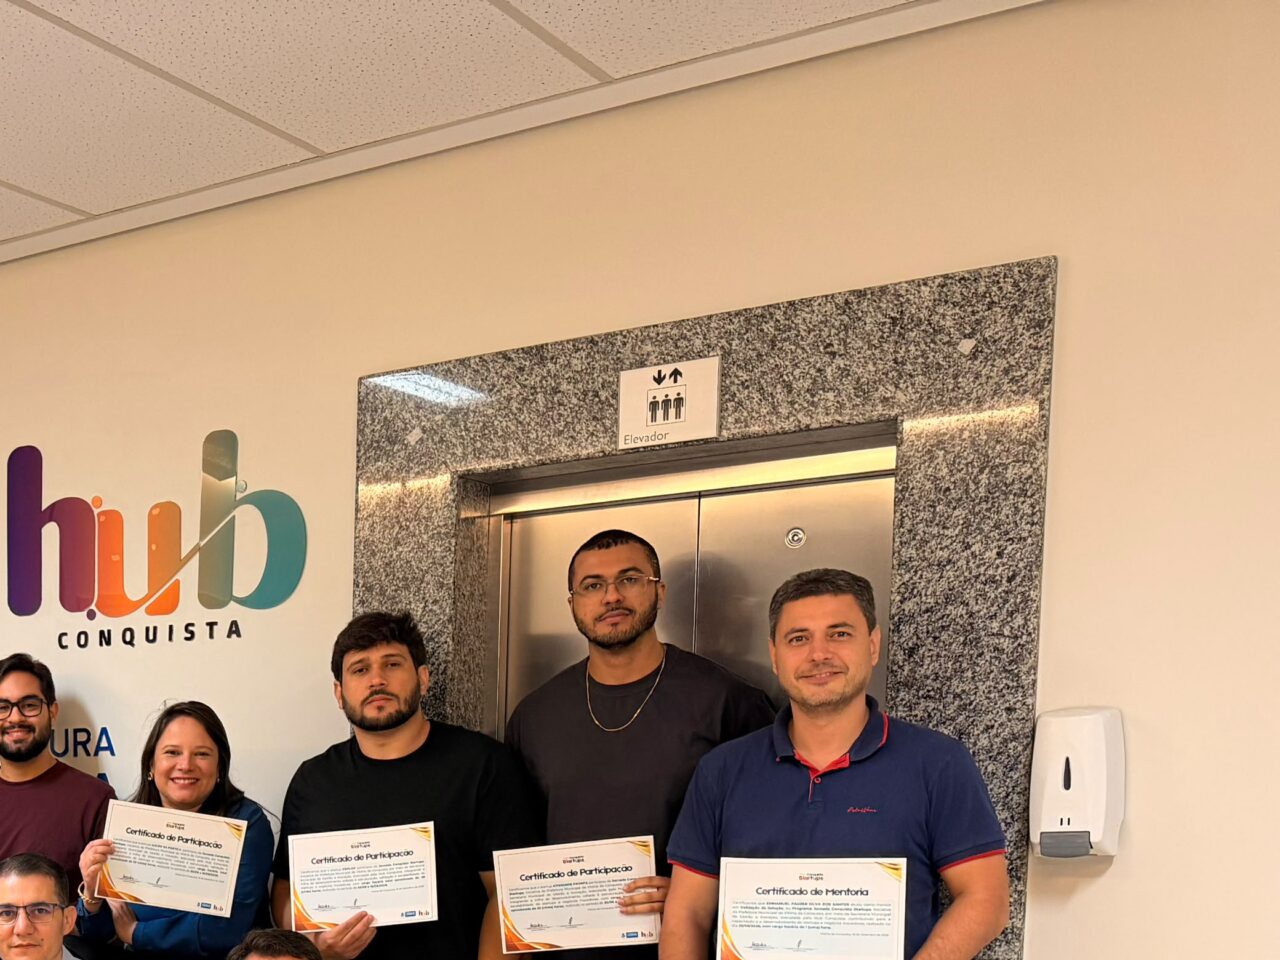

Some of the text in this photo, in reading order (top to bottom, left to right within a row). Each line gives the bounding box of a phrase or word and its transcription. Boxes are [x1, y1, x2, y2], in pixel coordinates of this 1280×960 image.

[623, 430, 670, 445] Elevador
[6, 428, 308, 619] hub
[57, 619, 242, 650] CONQUISTA
[125, 827, 166, 841] Certificado
[166, 833, 176, 842] de
[311, 854, 353, 865] Certificado
[353, 853, 365, 862] de
[519, 863, 633, 882] Certificado de Participação
[755, 887, 869, 896] Certificado de Mentoria
